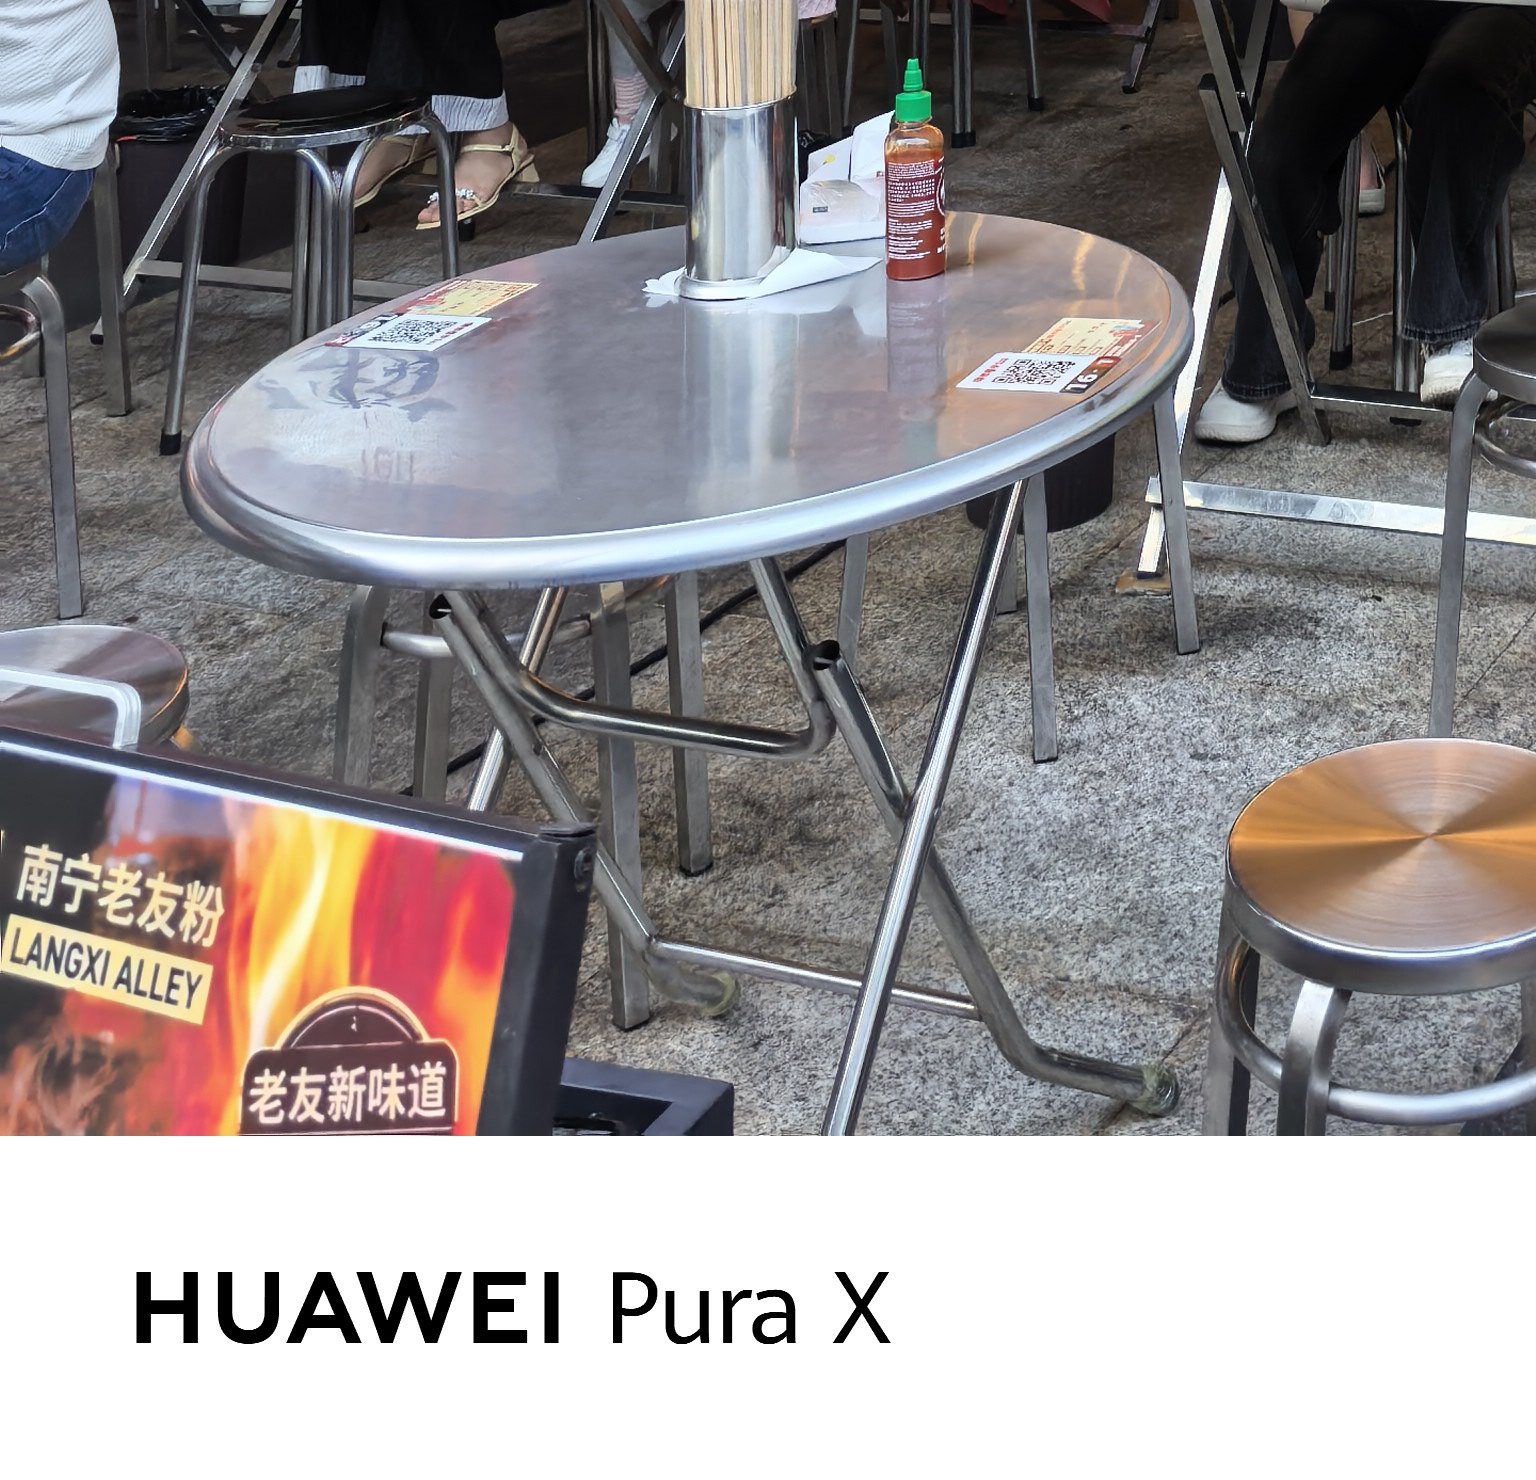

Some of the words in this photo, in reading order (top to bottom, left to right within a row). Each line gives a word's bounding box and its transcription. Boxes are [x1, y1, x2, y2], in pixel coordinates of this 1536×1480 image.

[16, 843, 224, 948] 南宁老友粉
[9, 926, 109, 988] LANGXI
[113, 958, 204, 1010] ALLEY
[248, 1060, 447, 1124] 老友新味道
